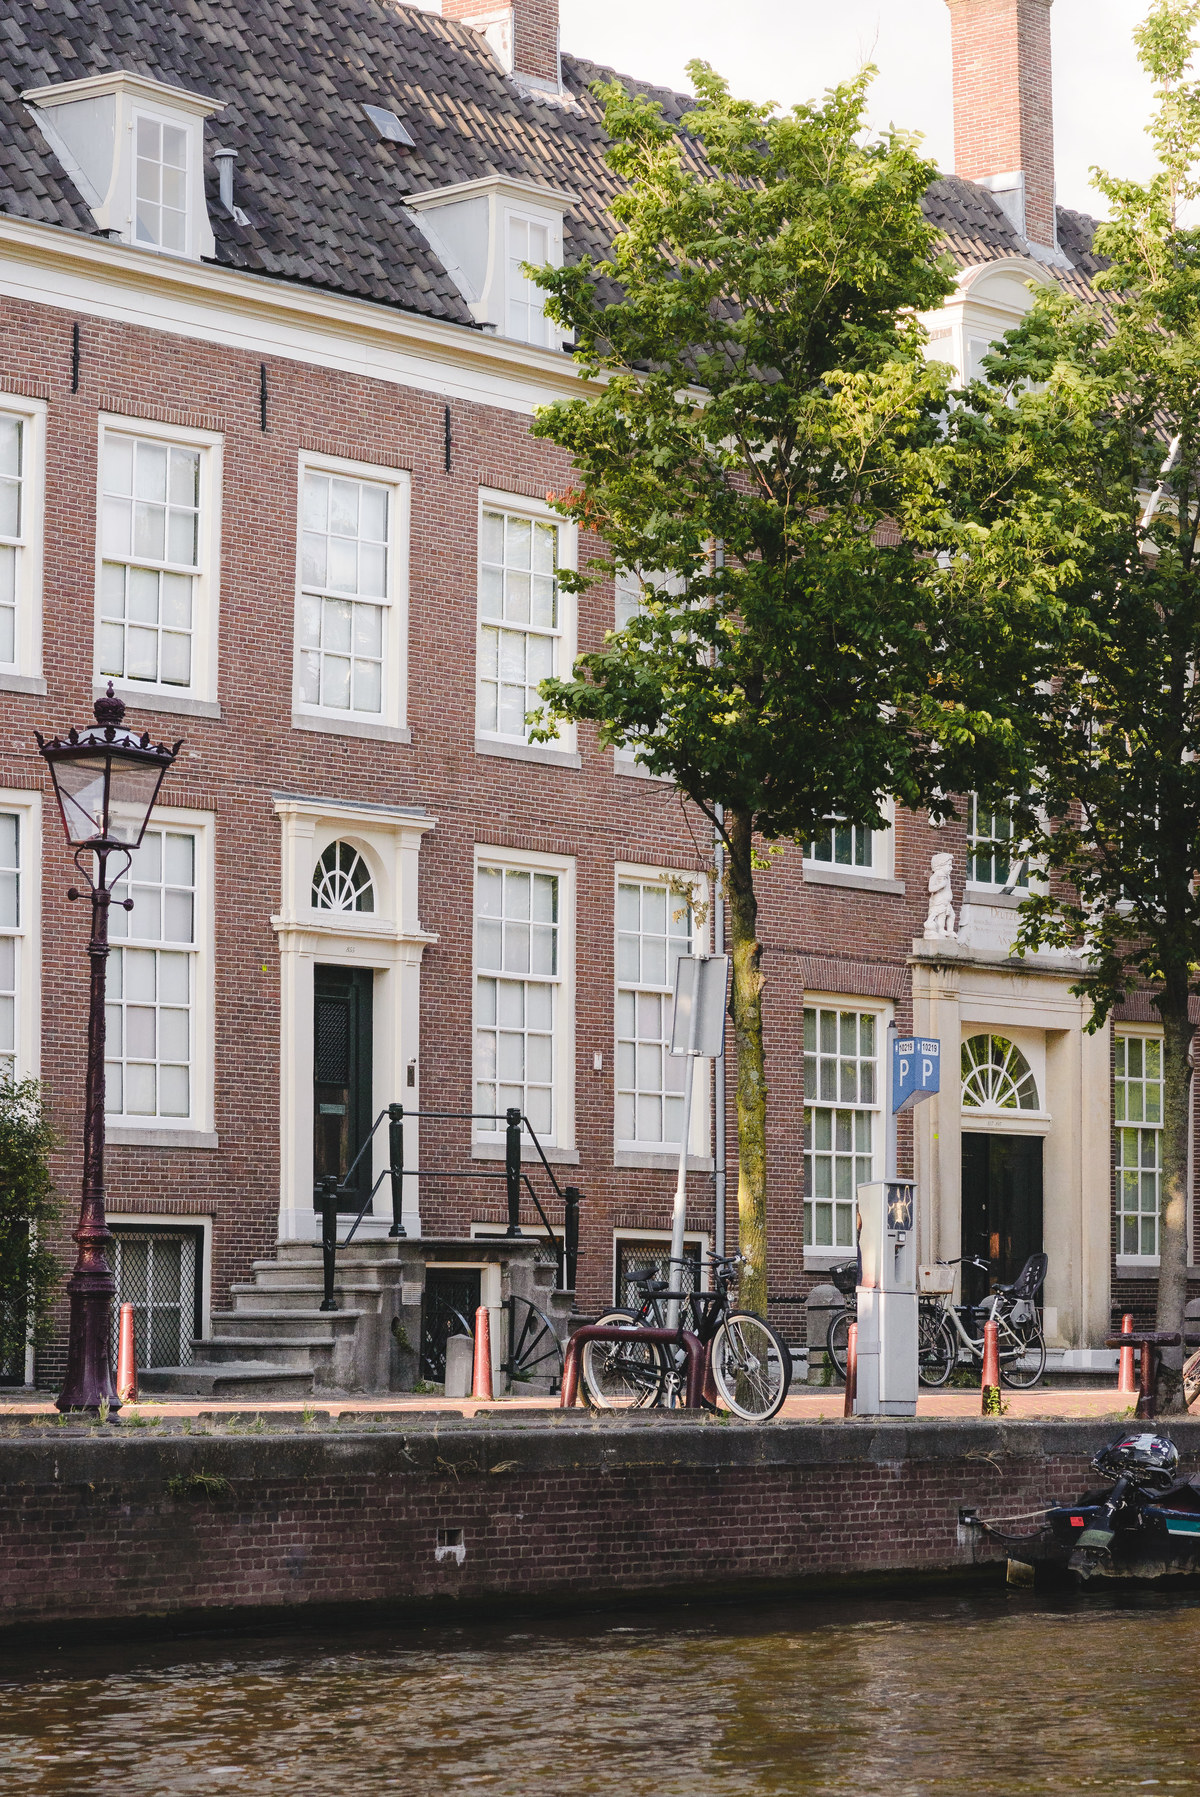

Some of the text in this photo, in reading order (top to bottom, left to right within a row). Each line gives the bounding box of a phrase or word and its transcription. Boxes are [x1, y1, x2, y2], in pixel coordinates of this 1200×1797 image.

[899, 1043, 912, 1051] 10219
[922, 1044, 937, 1052] 10219
[900, 1059, 909, 1086] P
[922, 1059, 932, 1086] P
